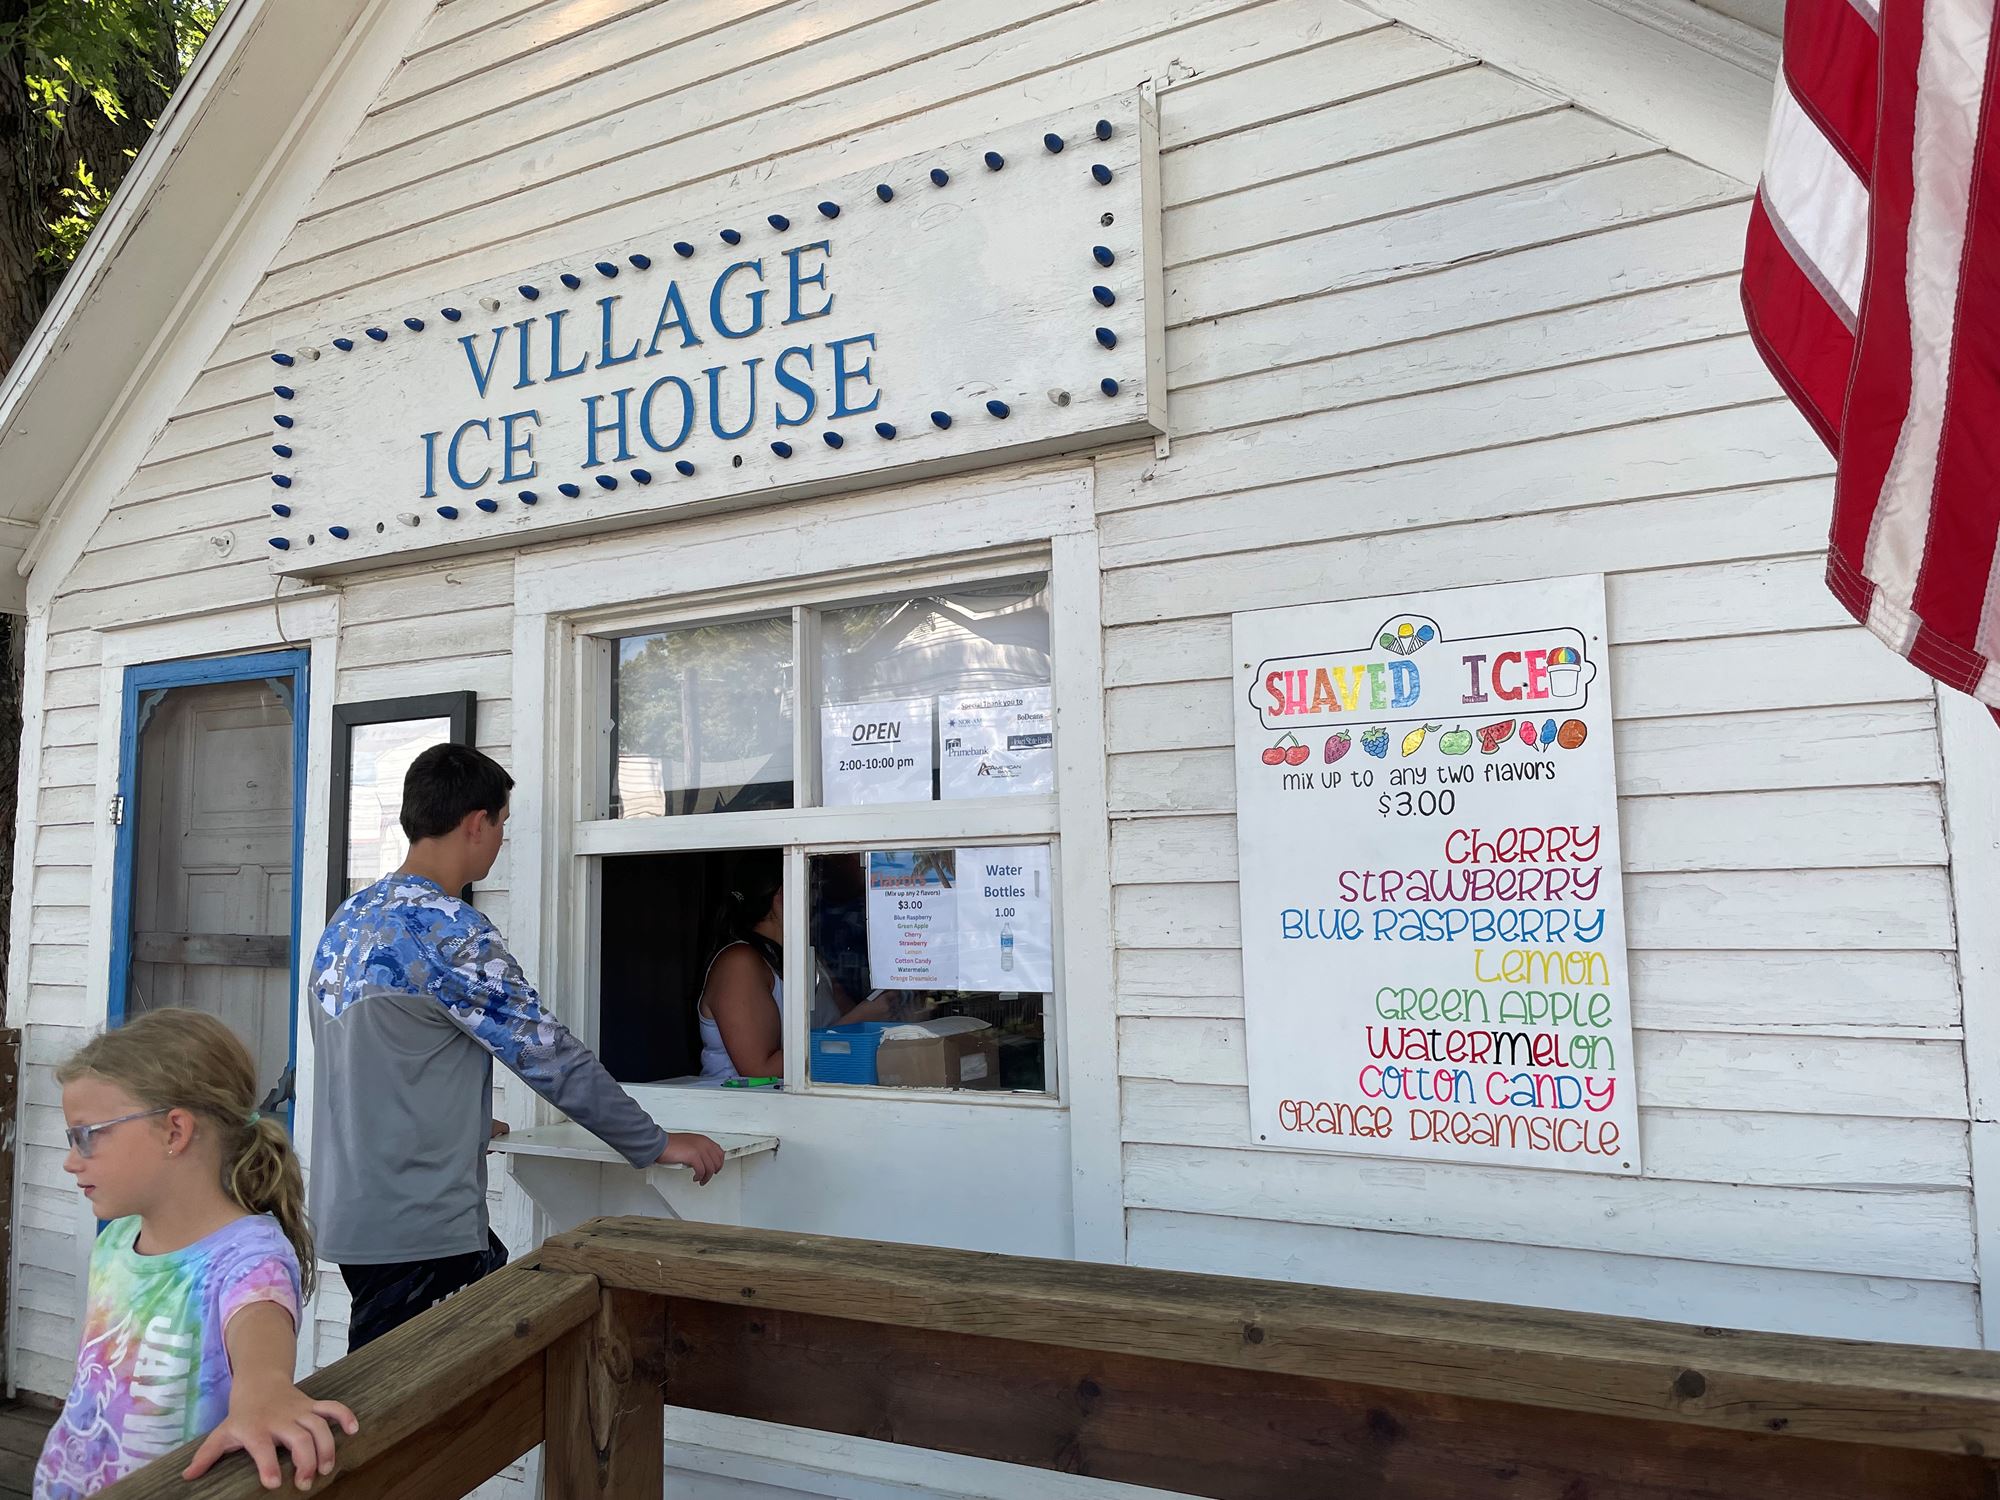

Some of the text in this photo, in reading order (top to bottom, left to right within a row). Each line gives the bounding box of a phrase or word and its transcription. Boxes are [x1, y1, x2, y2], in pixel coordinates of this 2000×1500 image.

[457, 239, 837, 399] VILLAGE
[419, 332, 882, 499] ICE HOUSE
[1265, 649, 1549, 717] SHAVED ICE
[852, 721, 901, 743] OPEN
[948, 746, 989, 757] Primebank
[839, 758, 914, 770] 2:00-10:00 pm
[1283, 772, 1314, 790] mix
[1350, 769, 1373, 787] to
[1390, 767, 1427, 785] any
[1484, 761, 1555, 782] flavors
[1378, 790, 1455, 818] $3.00
[986, 865, 1022, 876] Water
[984, 886, 1025, 898] Bottles
[898, 900, 923, 910] $3.00
[995, 908, 1015, 918] 1.00
